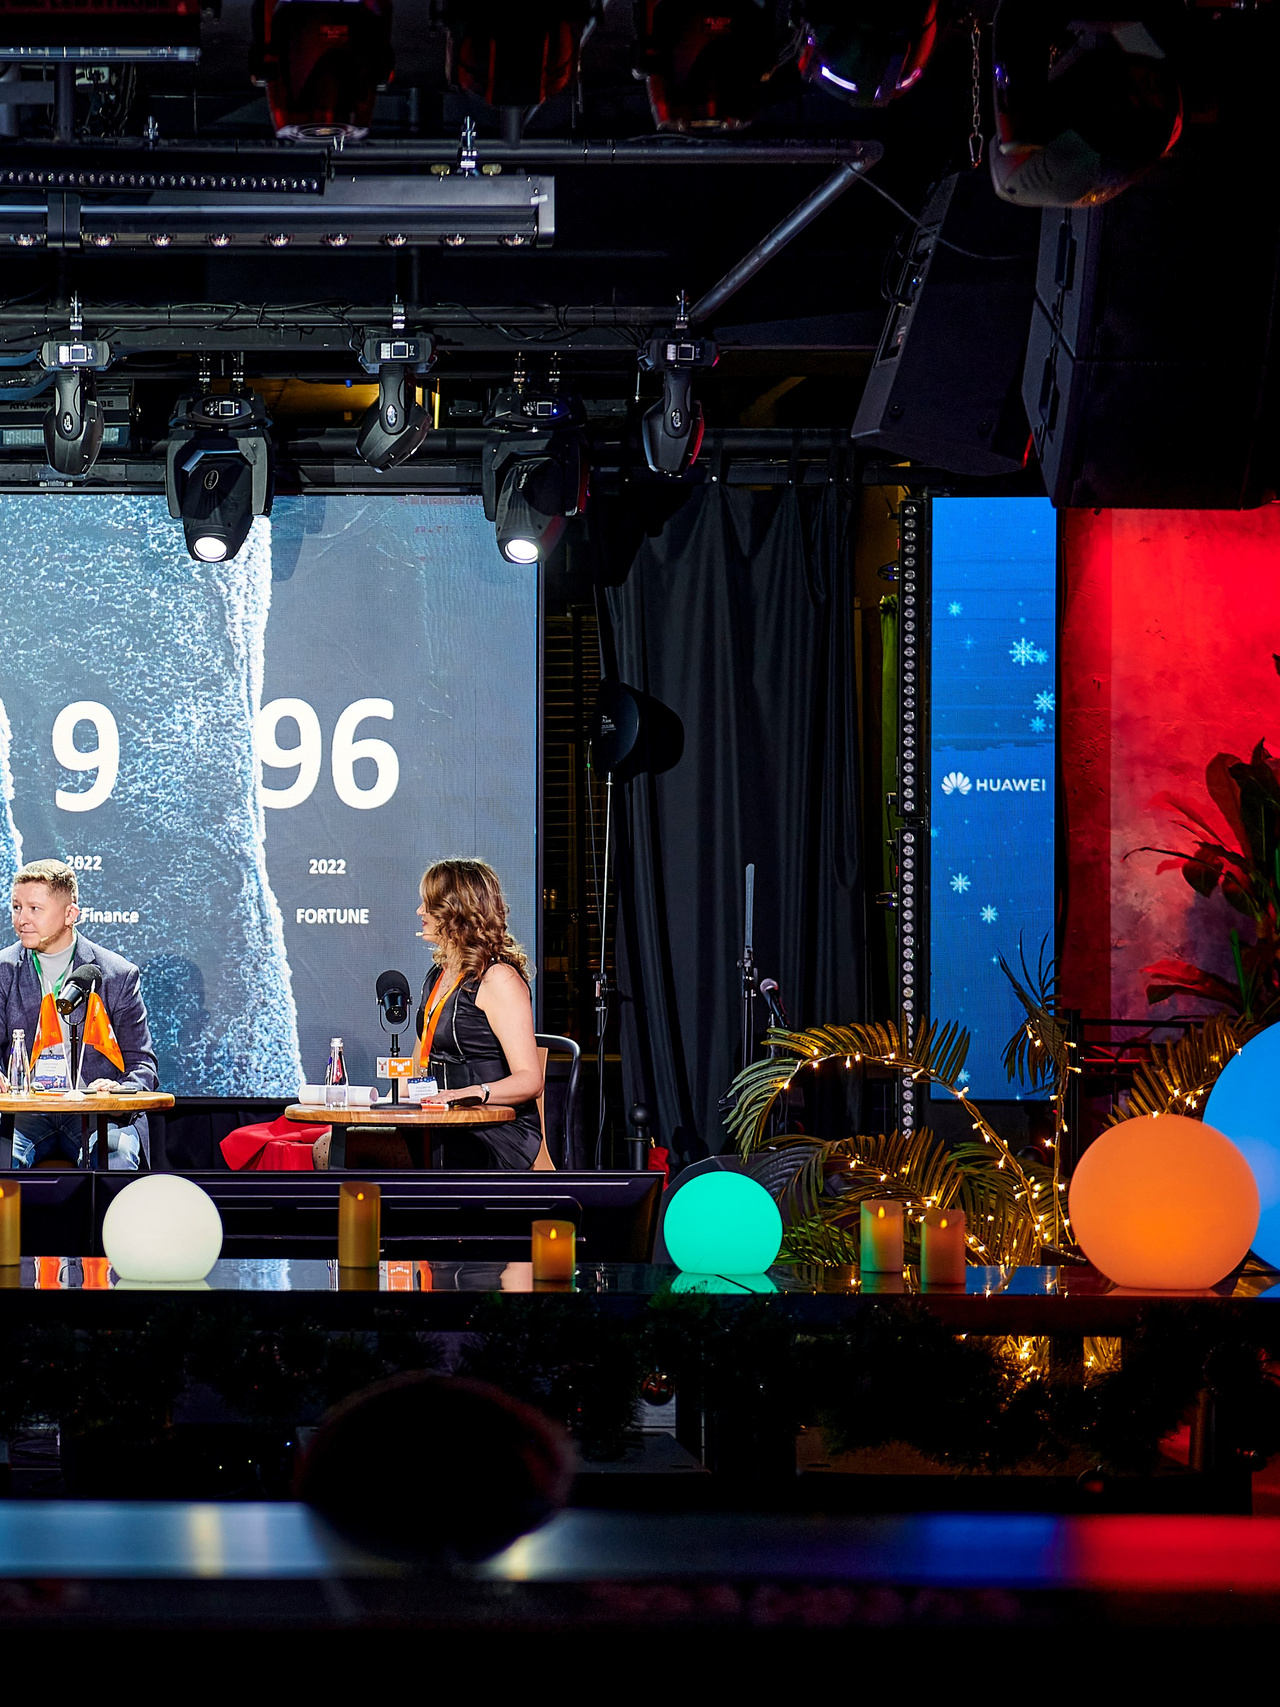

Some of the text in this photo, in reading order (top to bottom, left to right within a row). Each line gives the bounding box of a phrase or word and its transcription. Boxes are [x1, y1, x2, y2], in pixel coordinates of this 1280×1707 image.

[52, 700, 120, 812] 9
[257, 697, 400, 810] 96
[976, 778, 1046, 792] HUAWEI
[65, 855, 103, 871] 2022
[308, 858, 347, 875] 2022
[81, 907, 140, 923] Finance
[296, 908, 370, 924] FORTUNE
